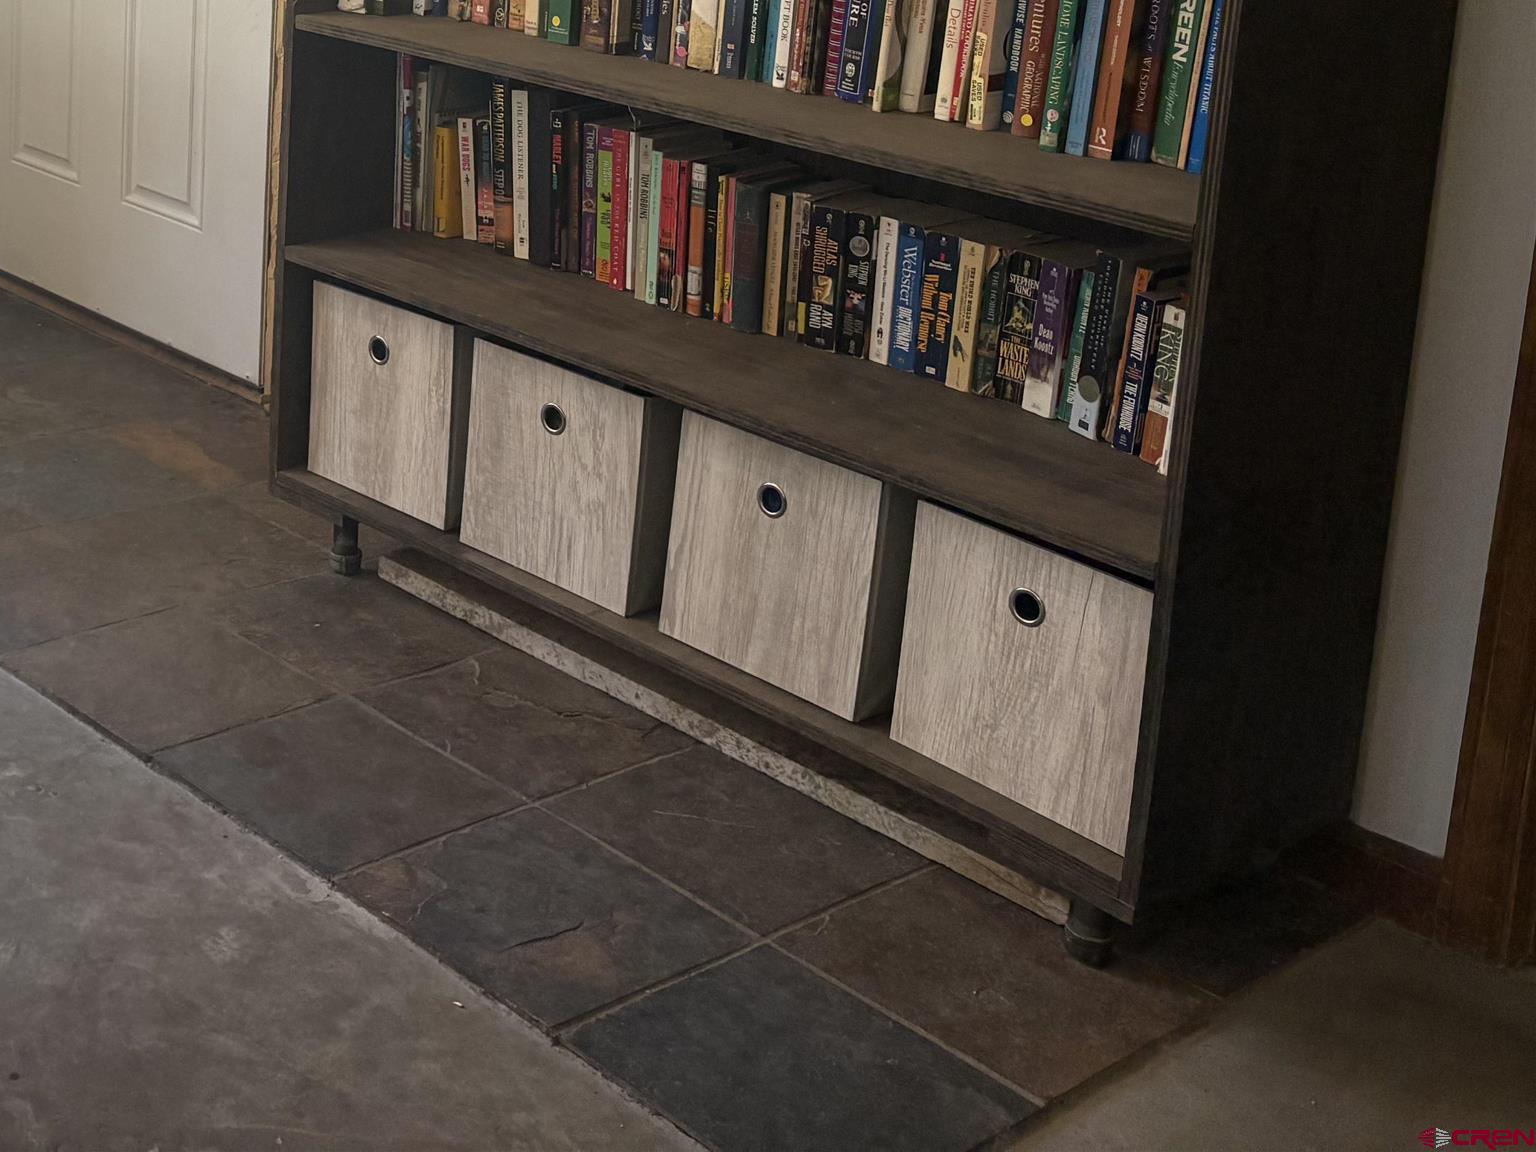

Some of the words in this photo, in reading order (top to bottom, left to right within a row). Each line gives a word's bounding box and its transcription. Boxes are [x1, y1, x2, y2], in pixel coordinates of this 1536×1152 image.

[860, 3, 869, 19] OF
[780, 15, 790, 43] BOOK
[945, 8, 961, 48] Details
[1009, 28, 1023, 72] HANDBOOK
[1048, 31, 1069, 105] LANDSCAPING
[492, 83, 504, 112] JAMES
[1019, 60, 1036, 113] GEOGRAPHIC
[1135, 57, 1153, 112] WISDOM
[1163, 63, 1184, 127] Encyclopedia
[461, 136, 469, 152] WAR
[493, 113, 505, 162] PATTERSON
[586, 131, 595, 150] TOM
[462, 154, 470, 171] DOGS
[585, 153, 594, 188] ROBBINS
[641, 173, 650, 188] TOM
[639, 189, 649, 220] ROBBINS
[812, 226, 828, 274] SHRUGGED
[826, 239, 838, 266] ATLAS
[847, 264, 859, 278] KING
[857, 261, 869, 286] STEPHEN
[899, 247, 918, 305] Webster
[921, 274, 939, 310] Without
[939, 291, 952, 312] Tom
[808, 304, 823, 329] RAND
[822, 309, 833, 329] AYN
[894, 306, 912, 352] DICTIONARY
[934, 313, 949, 344] Clancy
[1135, 313, 1148, 335] DEAN
[917, 311, 934, 353] Remorse
[999, 340, 1029, 363] WASTE
[1129, 334, 1145, 361] KOONTZ
[1154, 328, 1175, 381] KING
[996, 358, 1026, 381] LANDS
[1125, 381, 1138, 396] THE
[1118, 397, 1135, 432] FUNHOUSE
